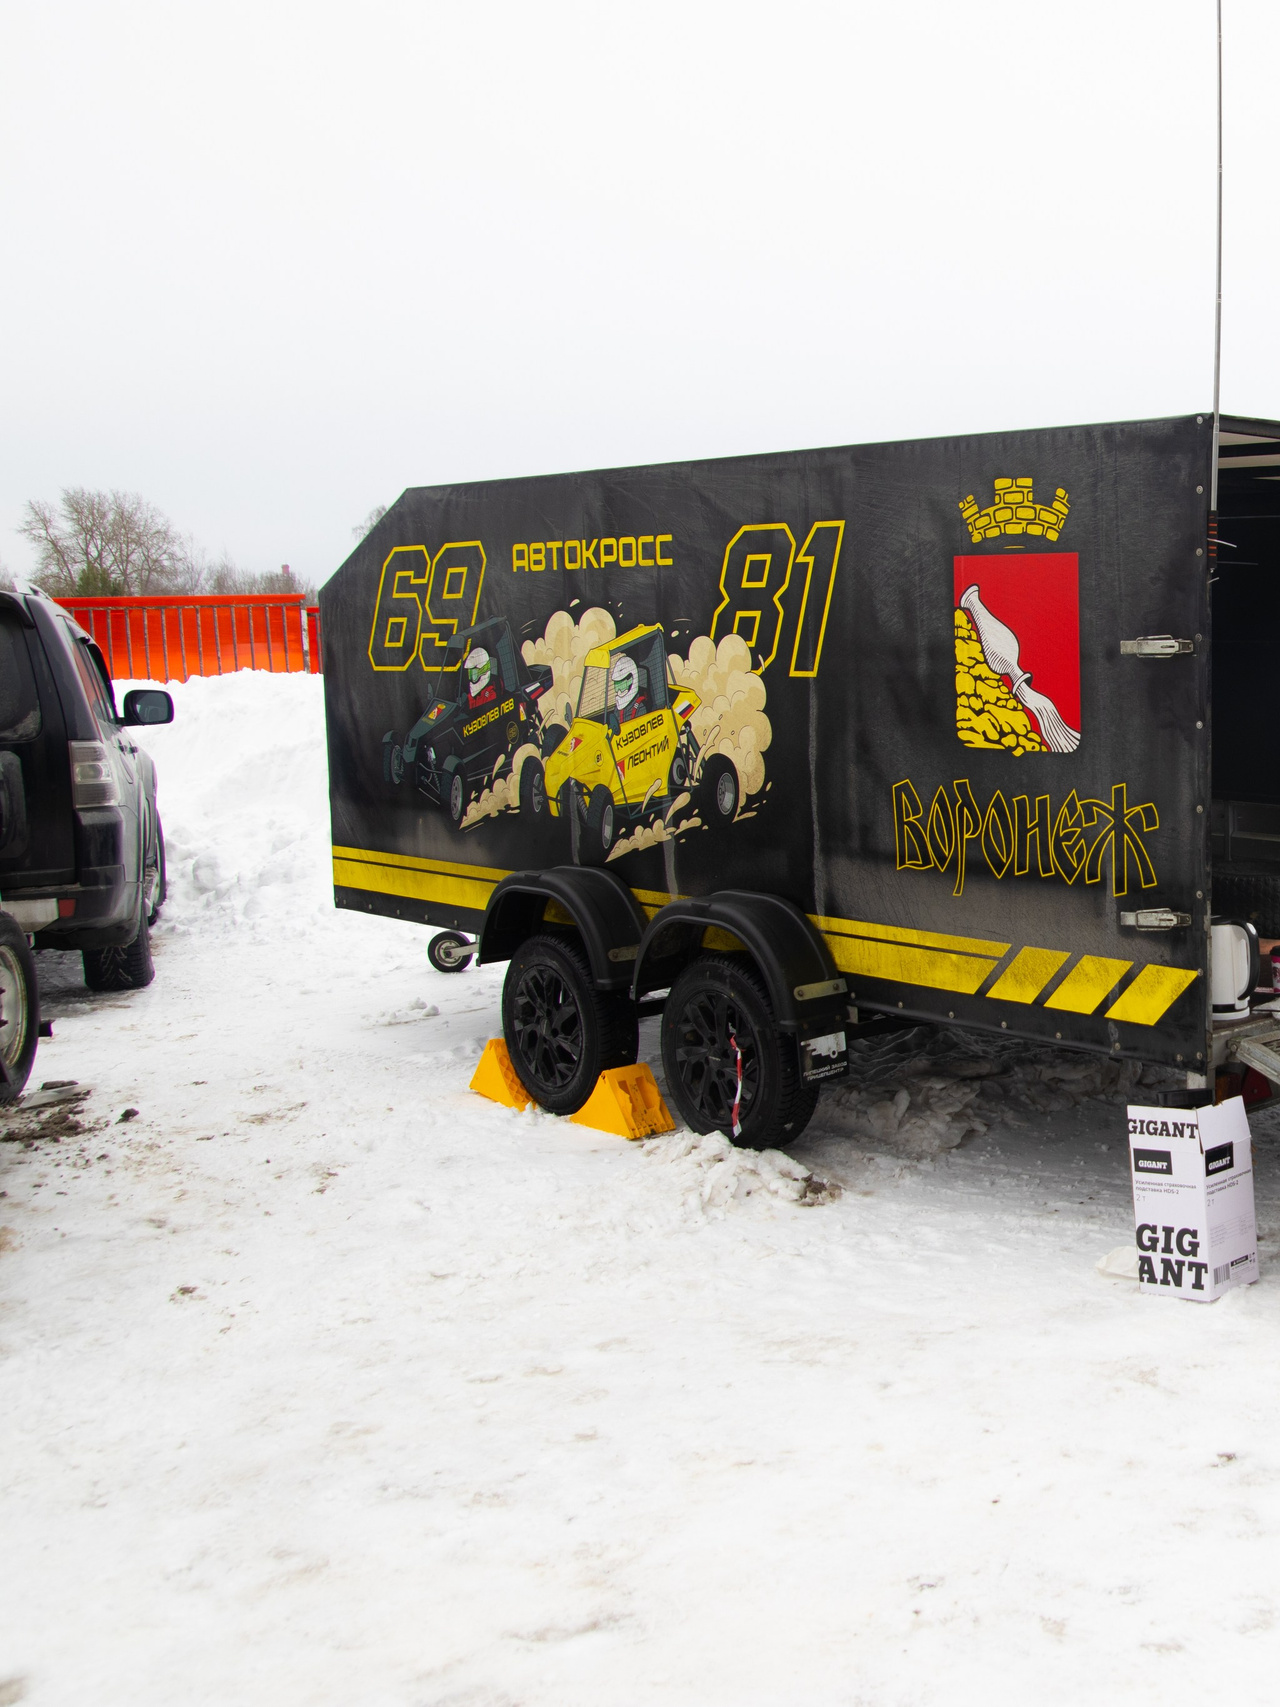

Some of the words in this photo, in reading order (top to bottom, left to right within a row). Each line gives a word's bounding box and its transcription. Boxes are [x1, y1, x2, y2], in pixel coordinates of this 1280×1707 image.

[512, 534, 674, 572] АВТОКРОСС
[368, 540, 488, 672] 69
[709, 520, 846, 678] 81
[462, 706, 500, 738] КУЗОВЛЕВ
[500, 698, 515, 716] ЛЕВ
[615, 713, 665, 751] КУЗОВЛЕВ
[627, 735, 670, 771] ЛЕОНТИЙ
[892, 778, 1160, 897] ВОРОНЕЖ
[1128, 1118, 1199, 1140] GIGANT
[1138, 1159, 1168, 1170] GIGANT
[1208, 1156, 1231, 1170] GIGANT
[1136, 1223, 1200, 1258] GIG
[1139, 1255, 1209, 1291] ANT
